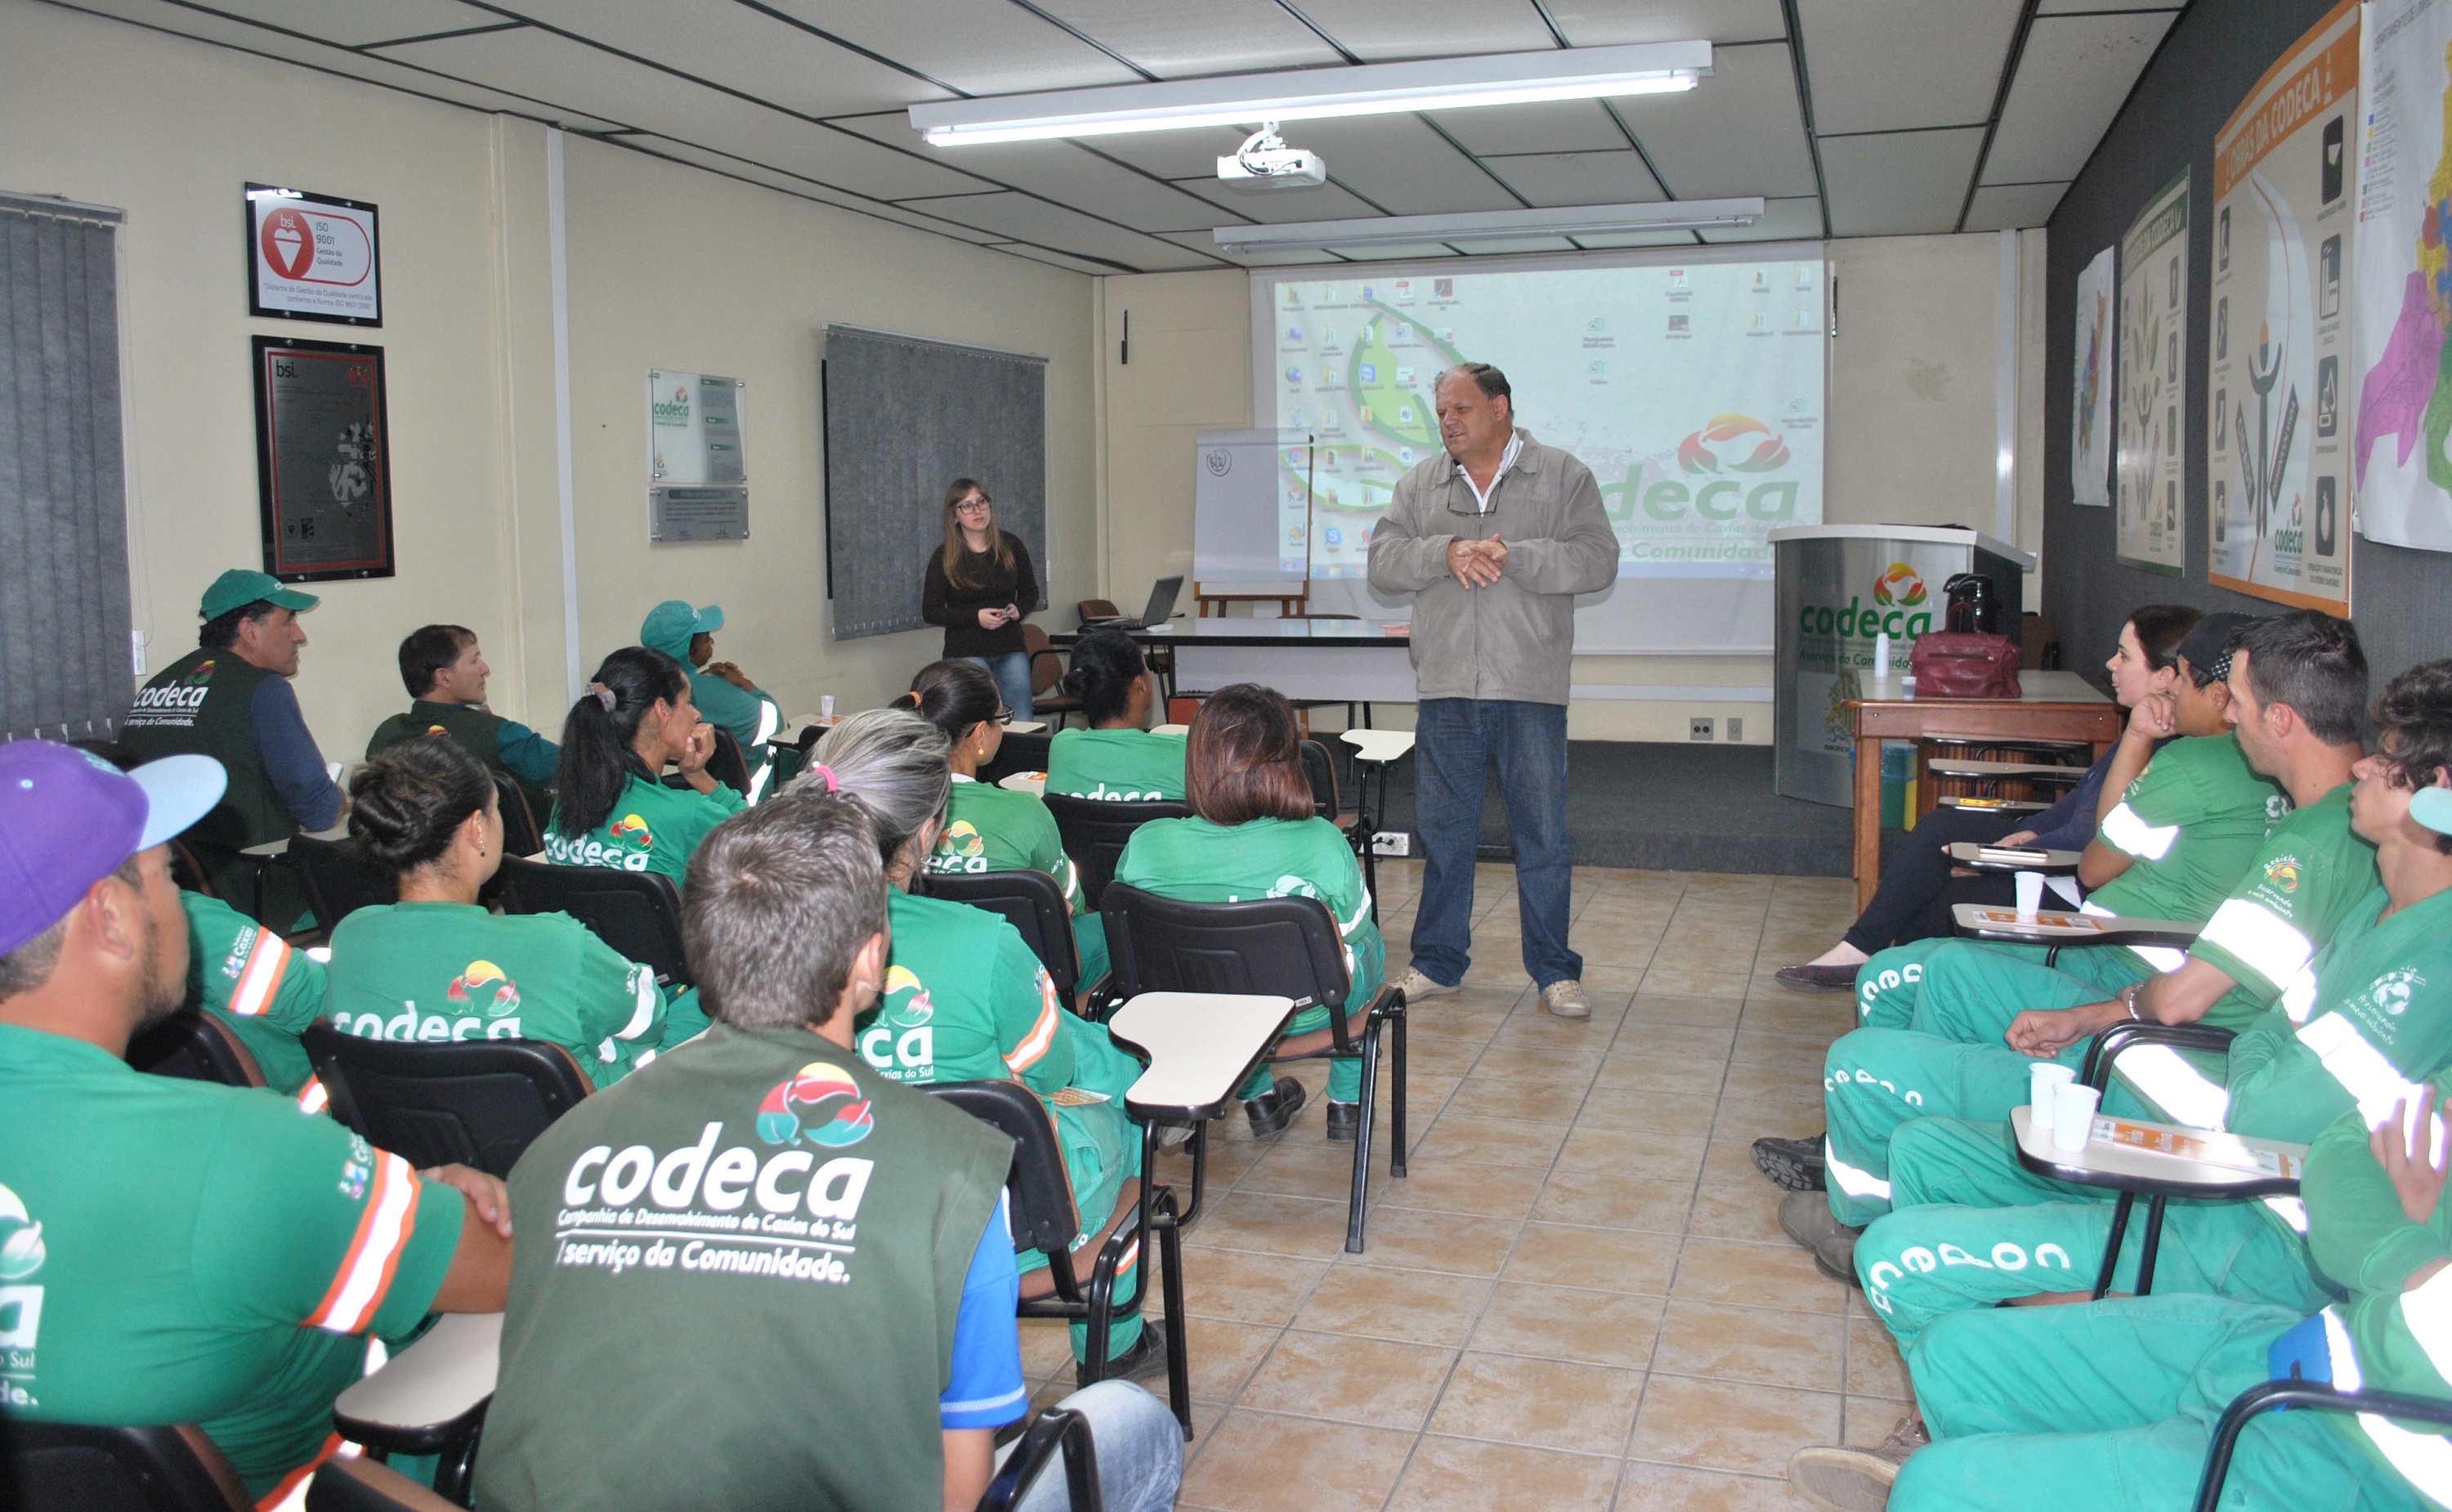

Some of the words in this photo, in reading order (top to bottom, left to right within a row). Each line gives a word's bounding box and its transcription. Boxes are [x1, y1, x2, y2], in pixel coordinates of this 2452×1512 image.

[2255, 112, 2270, 154] DA
[2271, 68, 2321, 140] CODECA
[315, 221, 329, 232] ISO
[316, 235, 335, 245] 9001
[317, 248, 335, 257] Gestão
[654, 399, 690, 418] codeca
[1600, 464, 1799, 521] deca
[1686, 523, 1701, 532] de
[1706, 522, 1747, 533] Caxias
[2275, 520, 2303, 554] codeca
[1800, 596, 1931, 641] codeca
[132, 679, 209, 708] codeca
[128, 718, 146, 728] serviço
[543, 832, 650, 871] codeca
[931, 856, 987, 873] eca
[905, 1069, 917, 1078] do
[919, 1065, 934, 1077] Sul
[564, 1121, 875, 1220] codeca
[557, 1207, 616, 1227] Companhia
[618, 1207, 633, 1224] de
[635, 1208, 741, 1229] Desenvolvimento
[741, 1213, 759, 1231] de
[761, 1214, 809, 1236] Caxias
[810, 1218, 831, 1238] do
[831, 1221, 857, 1241] Sul
[563, 1238, 642, 1274] serviço
[644, 1237, 678, 1267] da
[681, 1239, 852, 1284] Comunidade.
[1870, 1241, 2071, 1315] codeca
[11, 1351, 35, 1368] Sul
